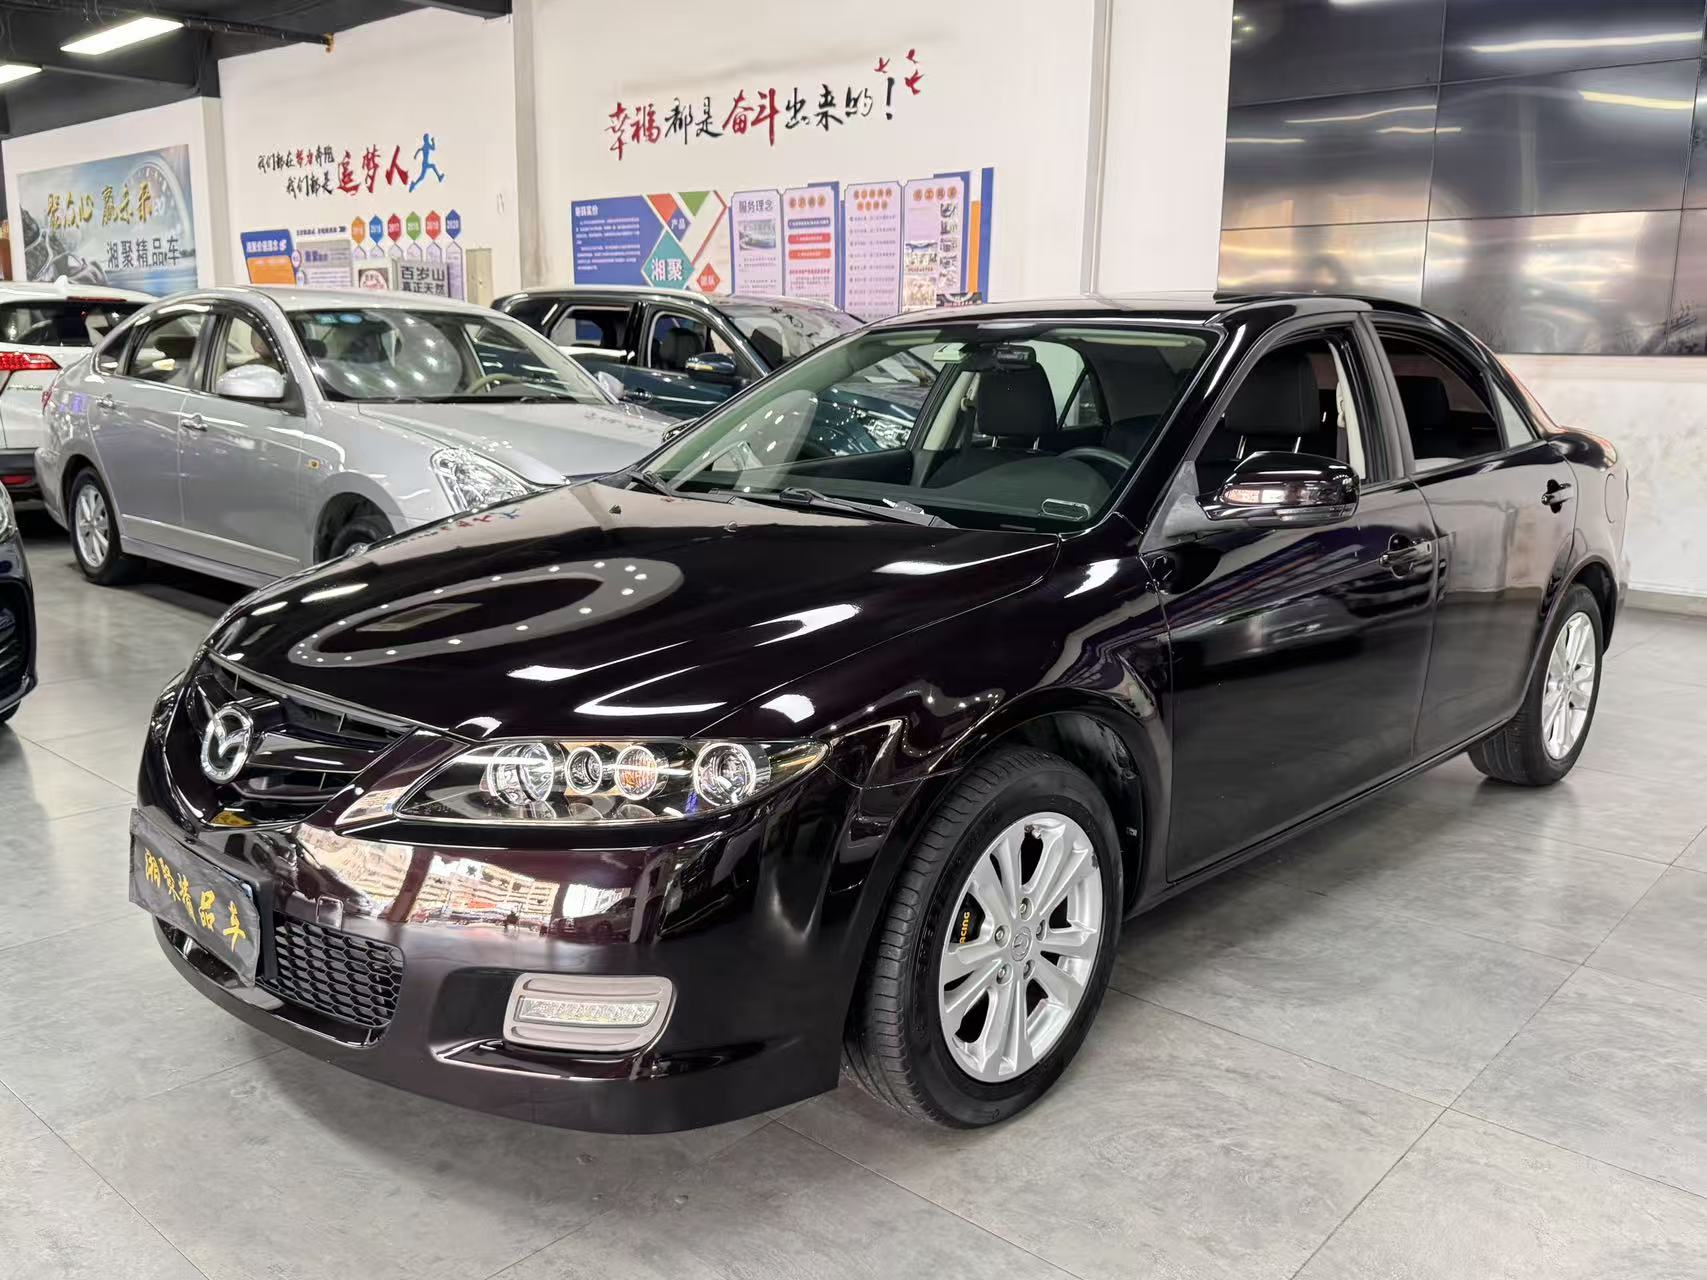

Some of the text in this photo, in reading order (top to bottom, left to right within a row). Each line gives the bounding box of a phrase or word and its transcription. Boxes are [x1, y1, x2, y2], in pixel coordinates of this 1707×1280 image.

[106, 236, 179, 269] 湘聚精品车
[401, 265, 445, 282] 百岁山
[651, 258, 684, 282] 湘聚
